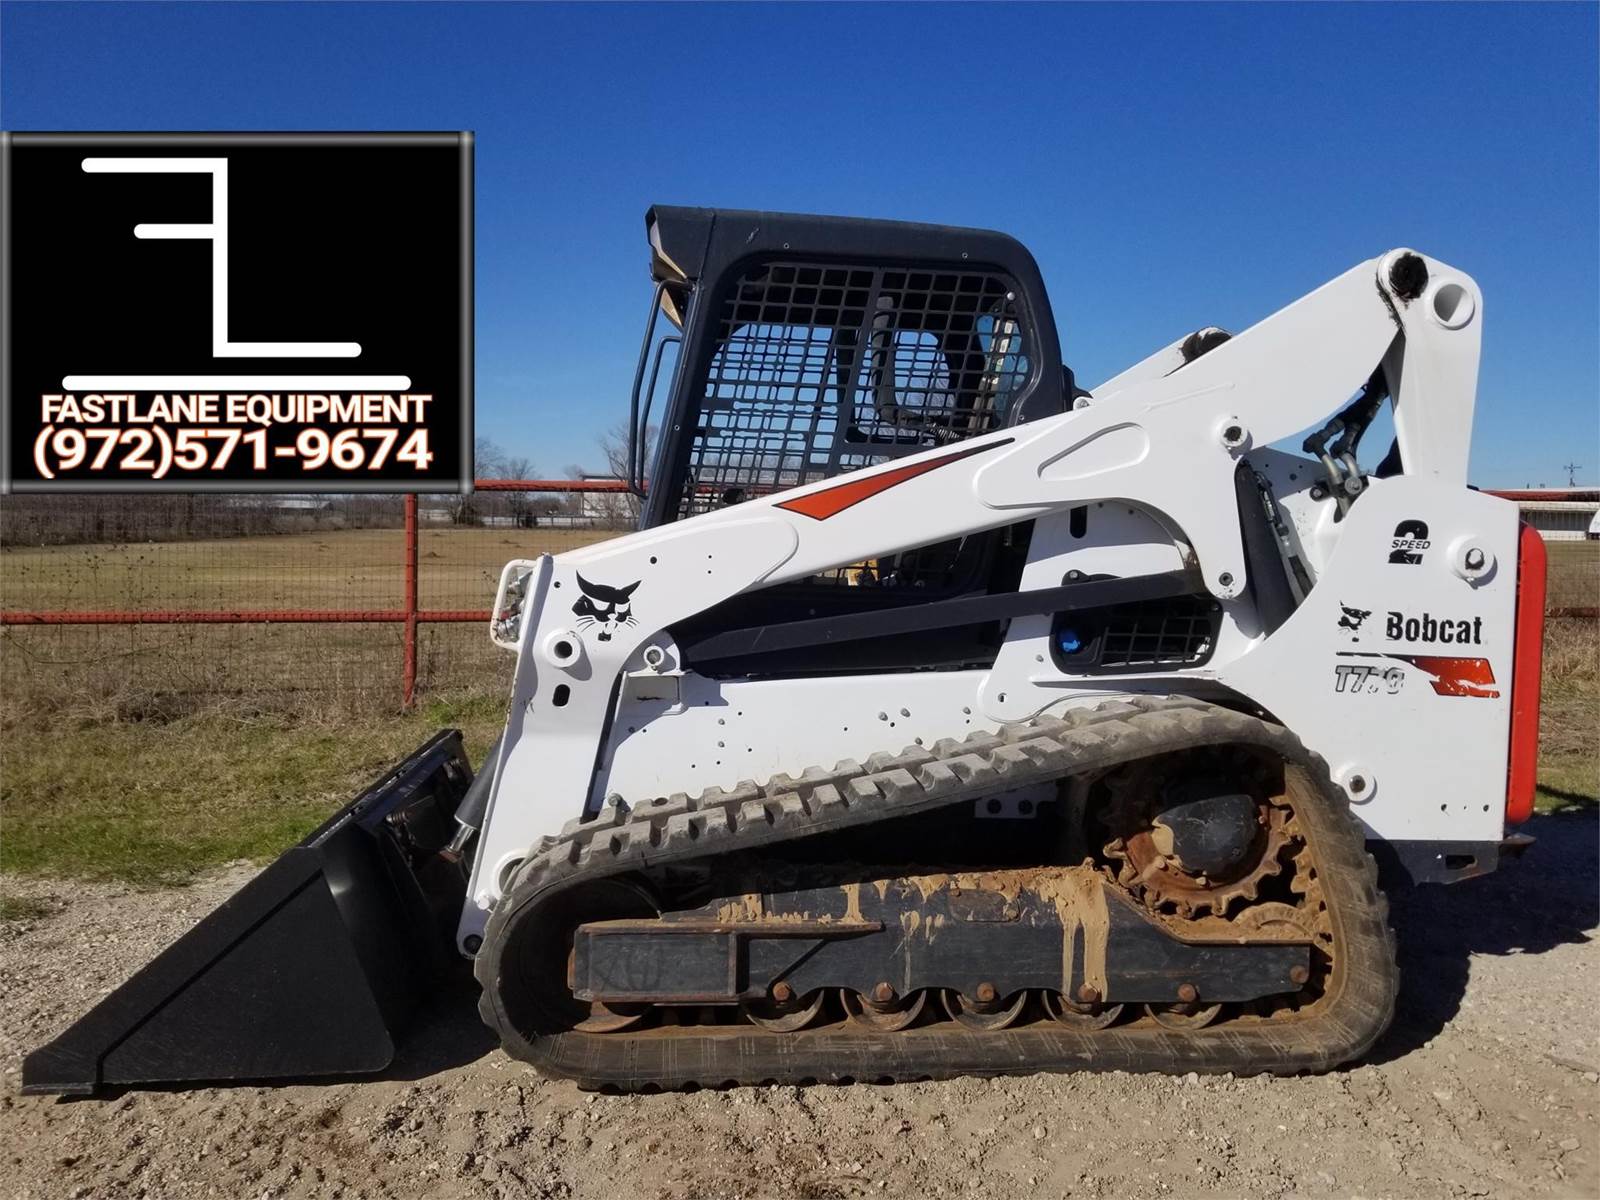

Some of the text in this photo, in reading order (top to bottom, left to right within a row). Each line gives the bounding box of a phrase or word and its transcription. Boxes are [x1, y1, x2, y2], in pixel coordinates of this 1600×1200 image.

[1388, 519, 1429, 564] 2
[1391, 539, 1431, 550] SPEED
[1386, 611, 1482, 644] Bobcat
